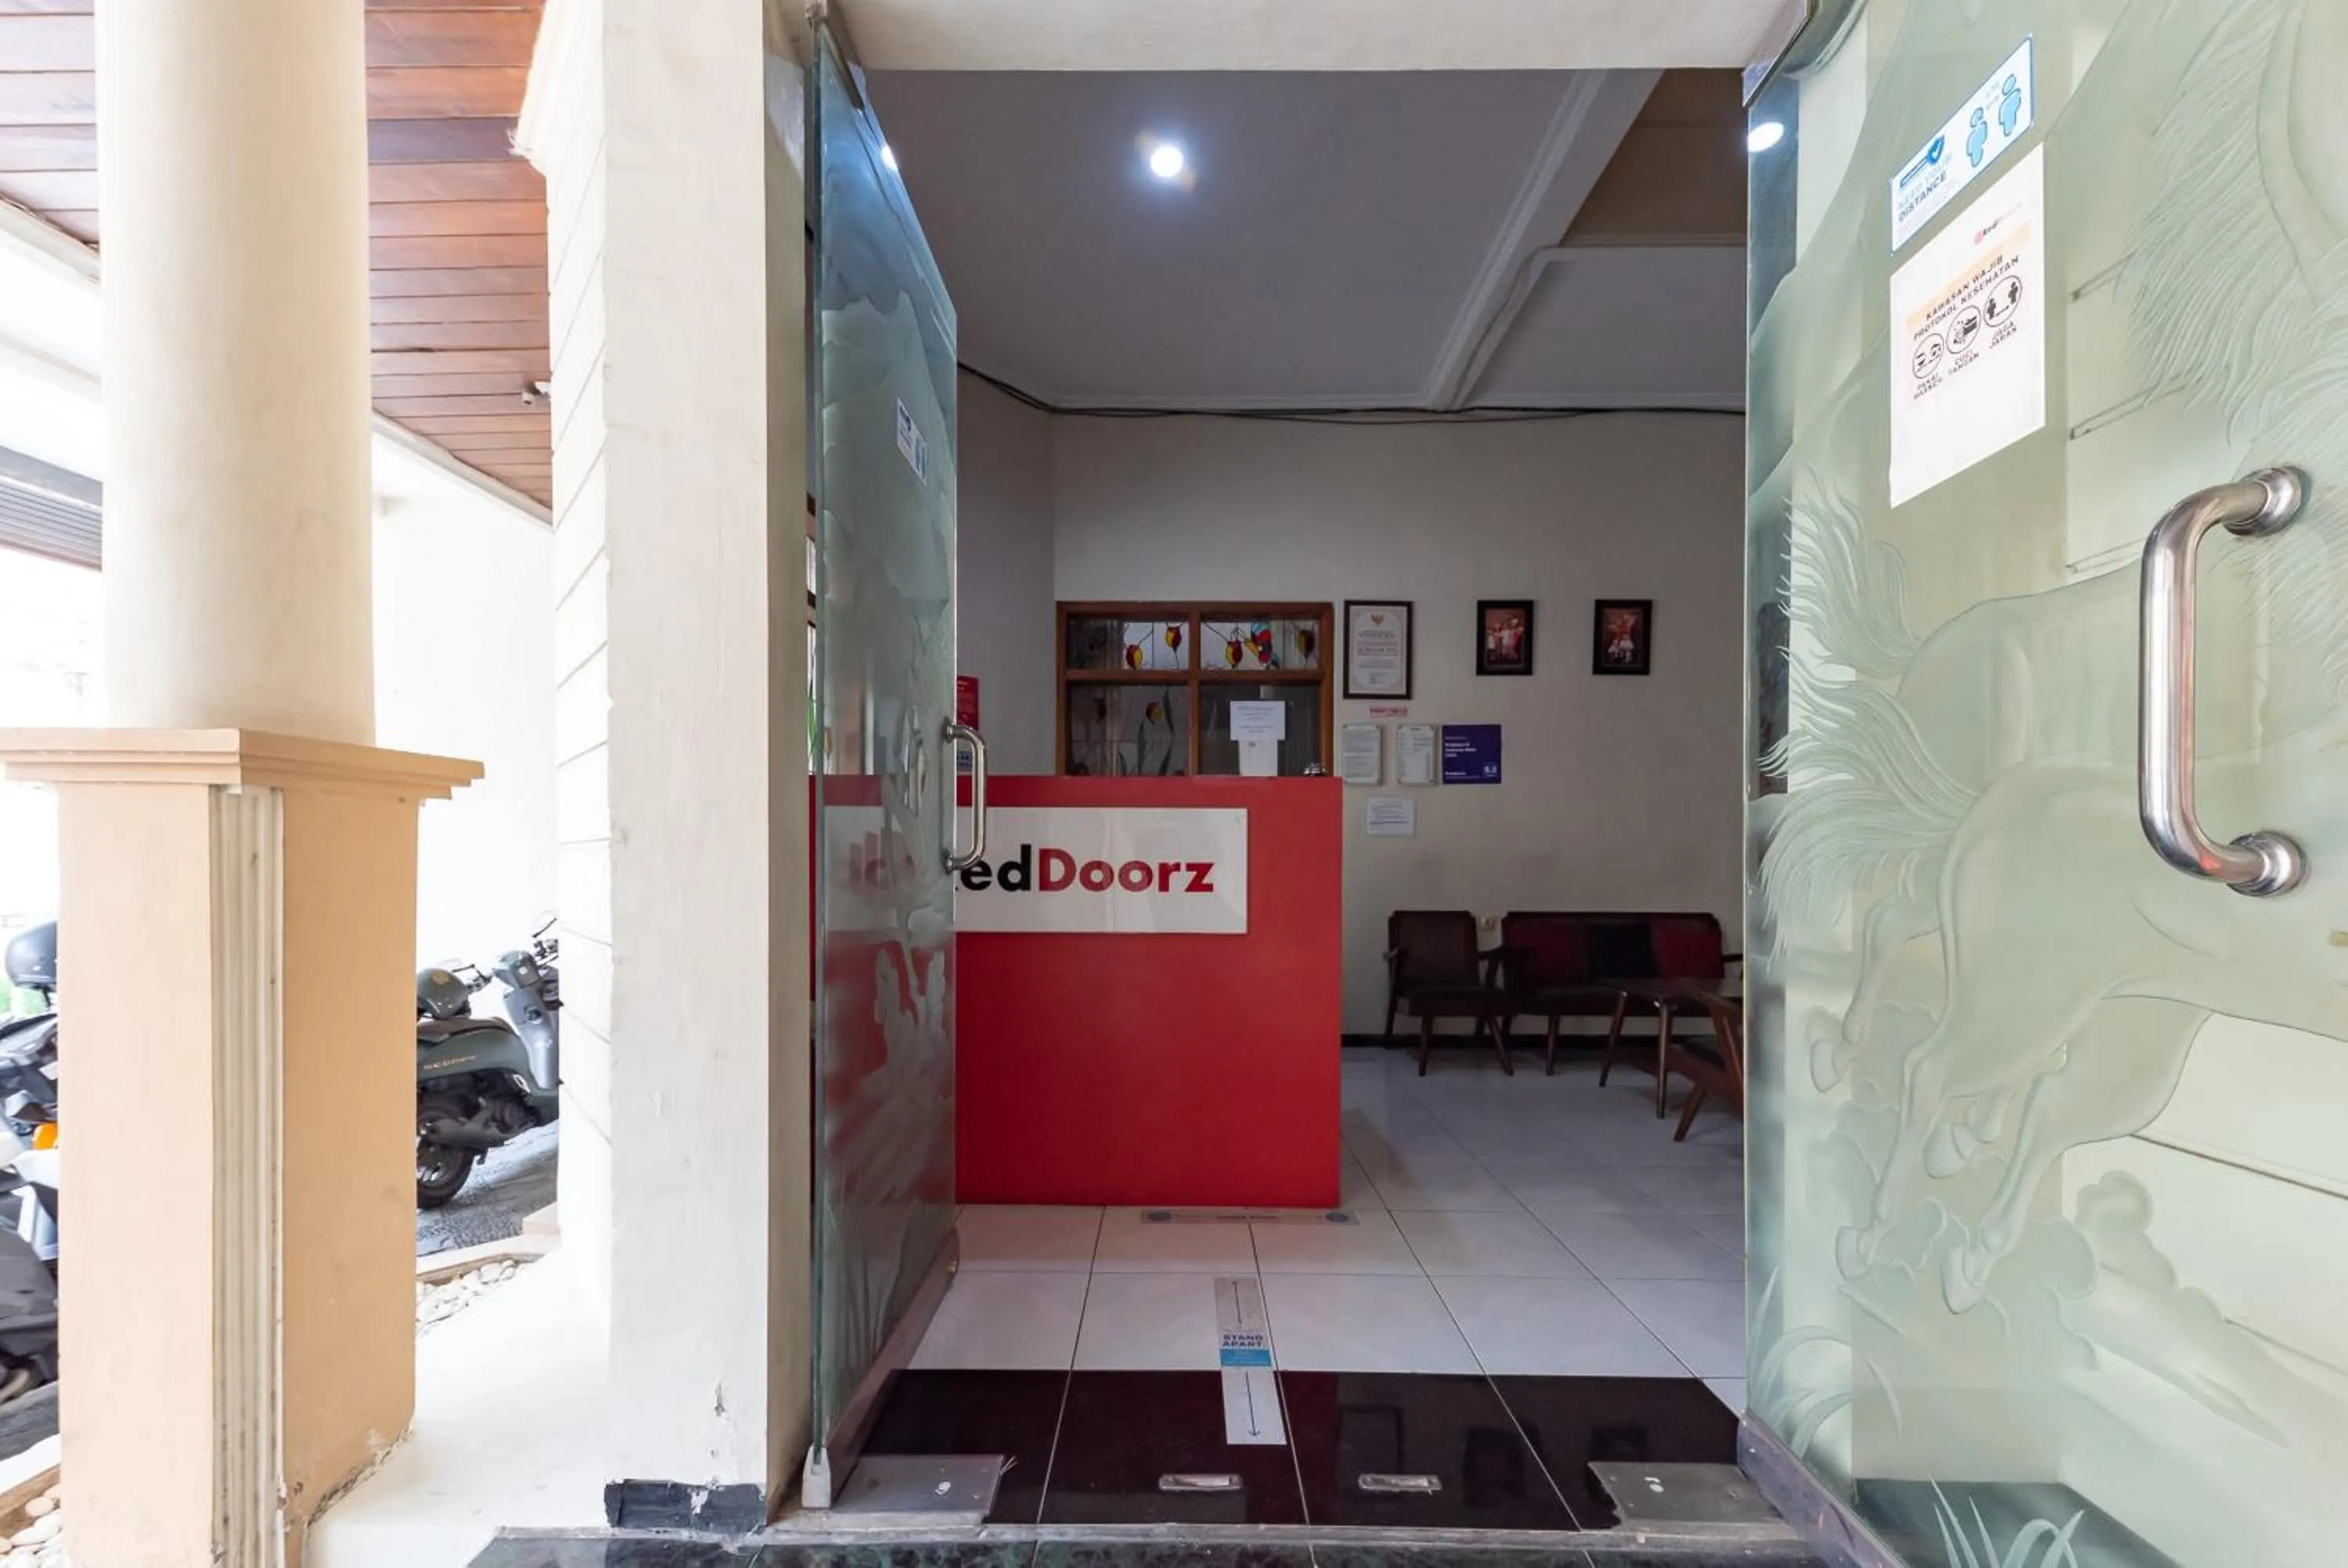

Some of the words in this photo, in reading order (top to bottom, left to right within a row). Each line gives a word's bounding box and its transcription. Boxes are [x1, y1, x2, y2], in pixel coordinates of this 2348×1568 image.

[1898, 170, 1946, 222] DISTANCE
[1914, 303, 1957, 341] PROTOKOL
[1960, 254, 2019, 305] KESEHATAN
[1926, 281, 1971, 320] KAWASAN
[1972, 254, 2004, 285] WAJIB
[955, 844, 1215, 893] edDoorz
